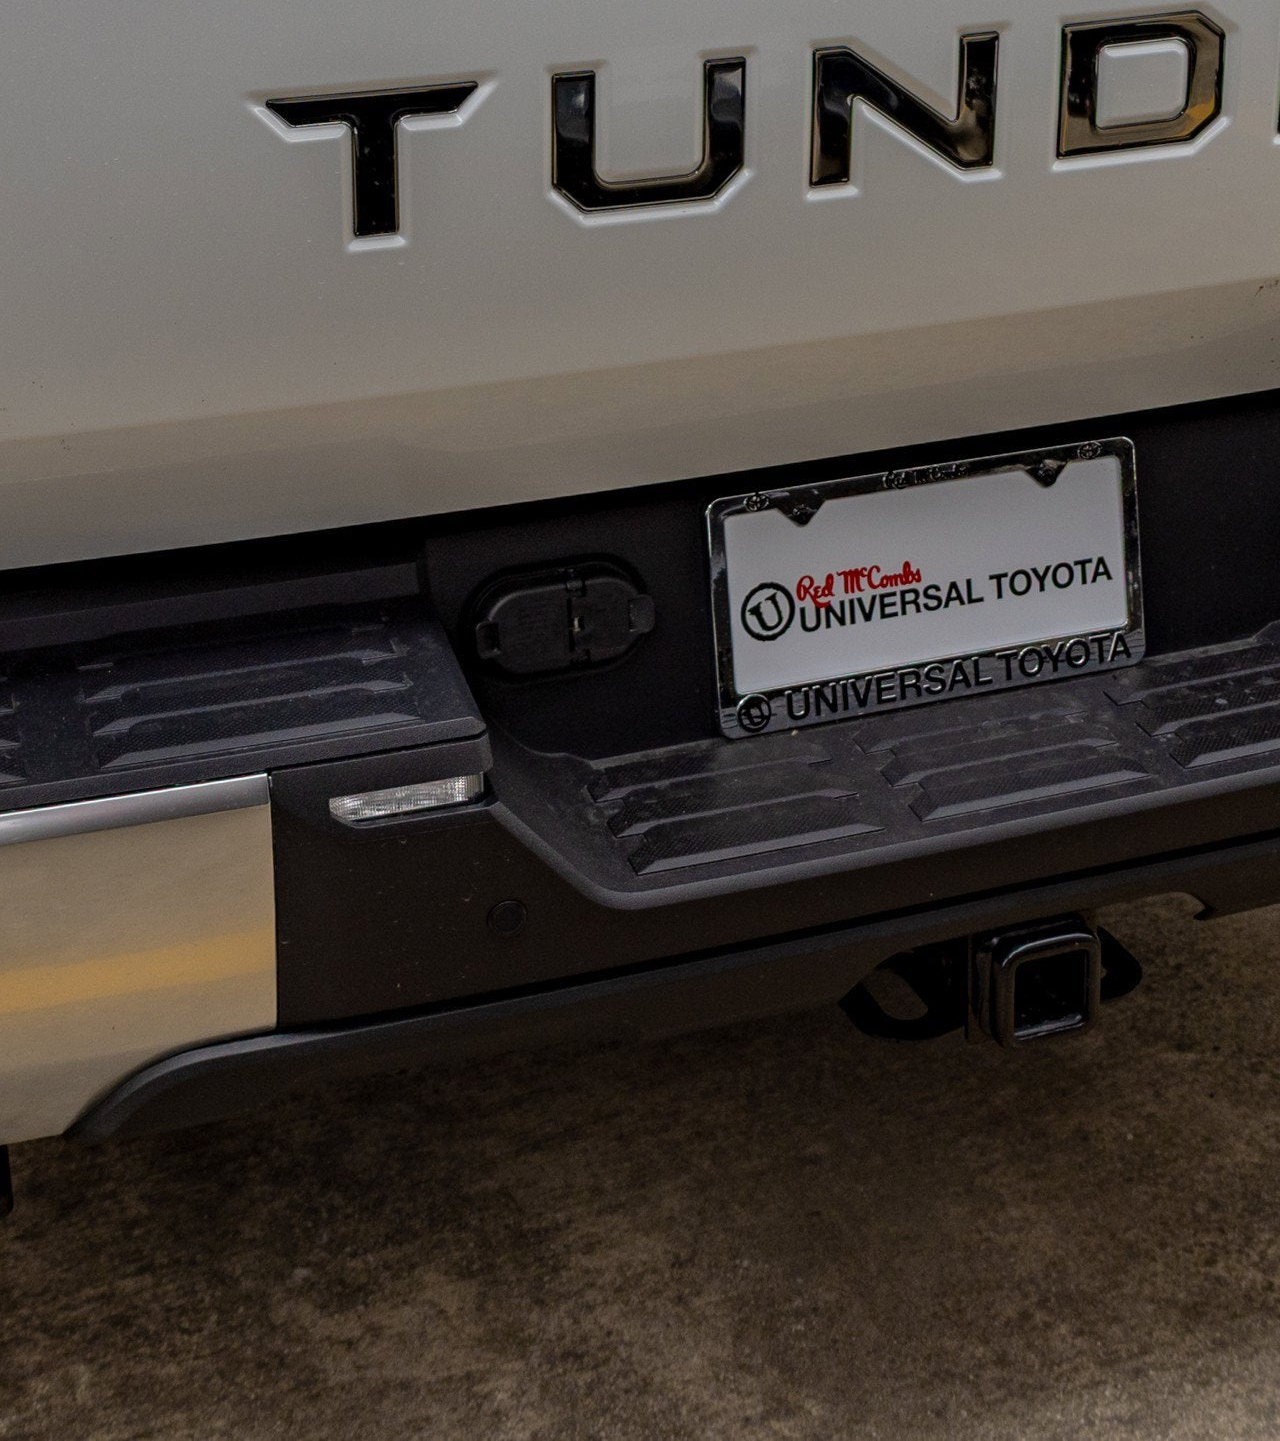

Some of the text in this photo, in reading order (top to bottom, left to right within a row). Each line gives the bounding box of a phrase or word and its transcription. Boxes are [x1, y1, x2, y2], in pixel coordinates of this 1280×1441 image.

[797, 561, 922, 608] Red McCombs
[798, 556, 1113, 632] UNIVERSAL TOYOTA
[785, 659, 993, 721] UNIVERSAL
[995, 632, 1133, 680] TOYOTA
